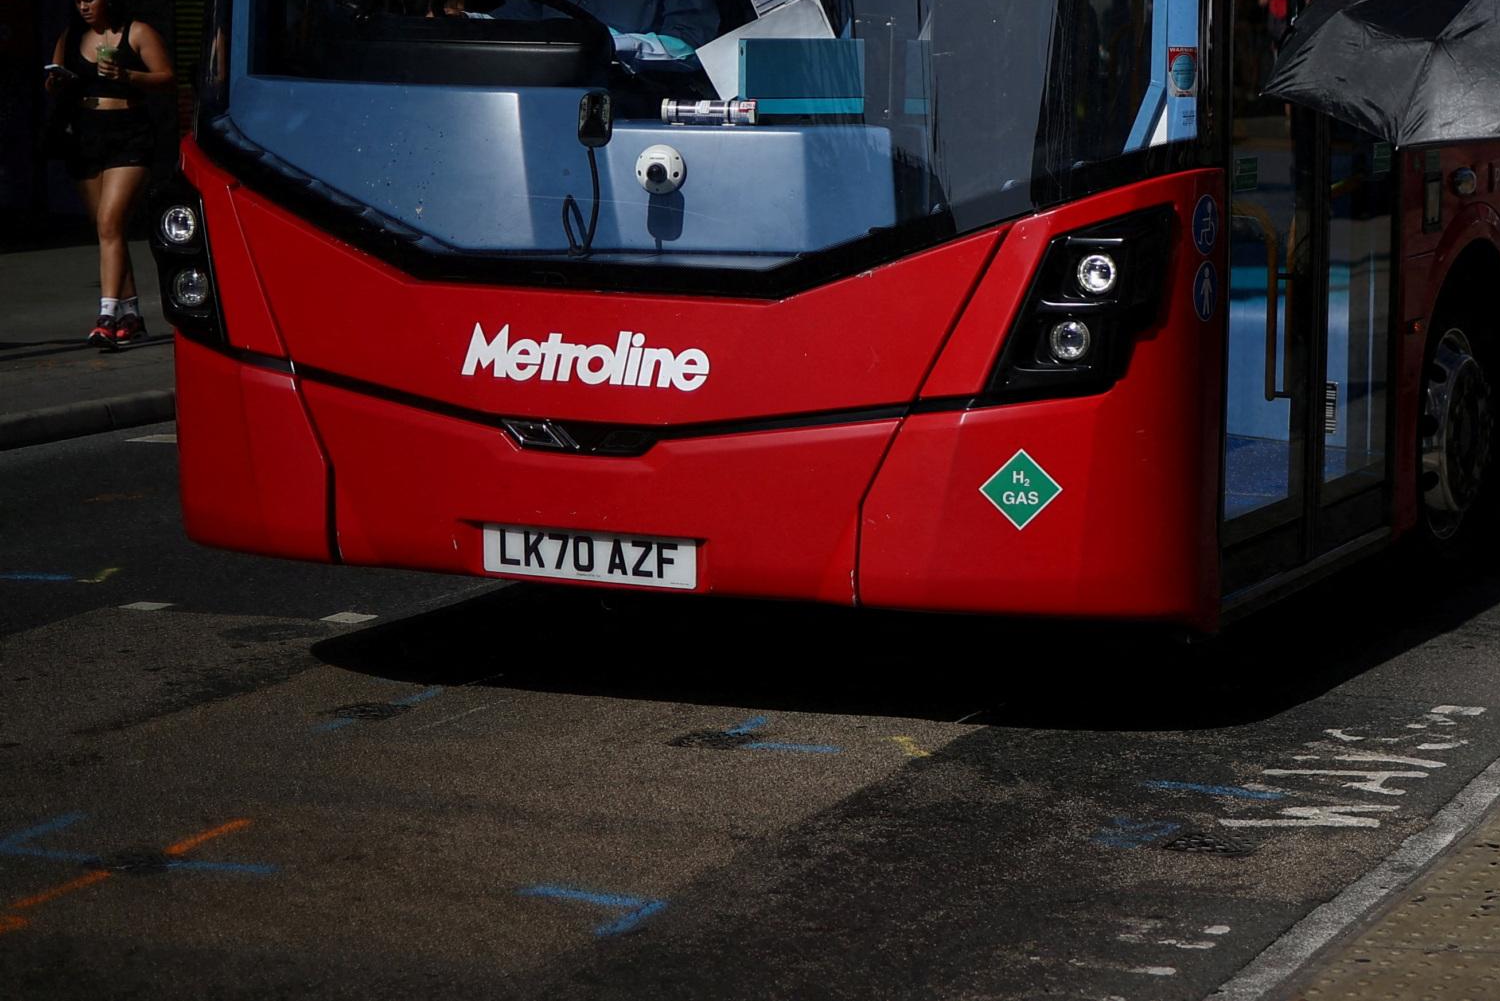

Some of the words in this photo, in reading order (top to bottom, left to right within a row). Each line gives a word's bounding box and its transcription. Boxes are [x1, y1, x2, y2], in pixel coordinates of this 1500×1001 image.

[461, 321, 710, 392] Metroline
[1012, 470, 1030, 487] H2
[1002, 491, 1039, 505] GAS
[500, 528, 594, 572] LK70
[608, 539, 678, 579] AZF
